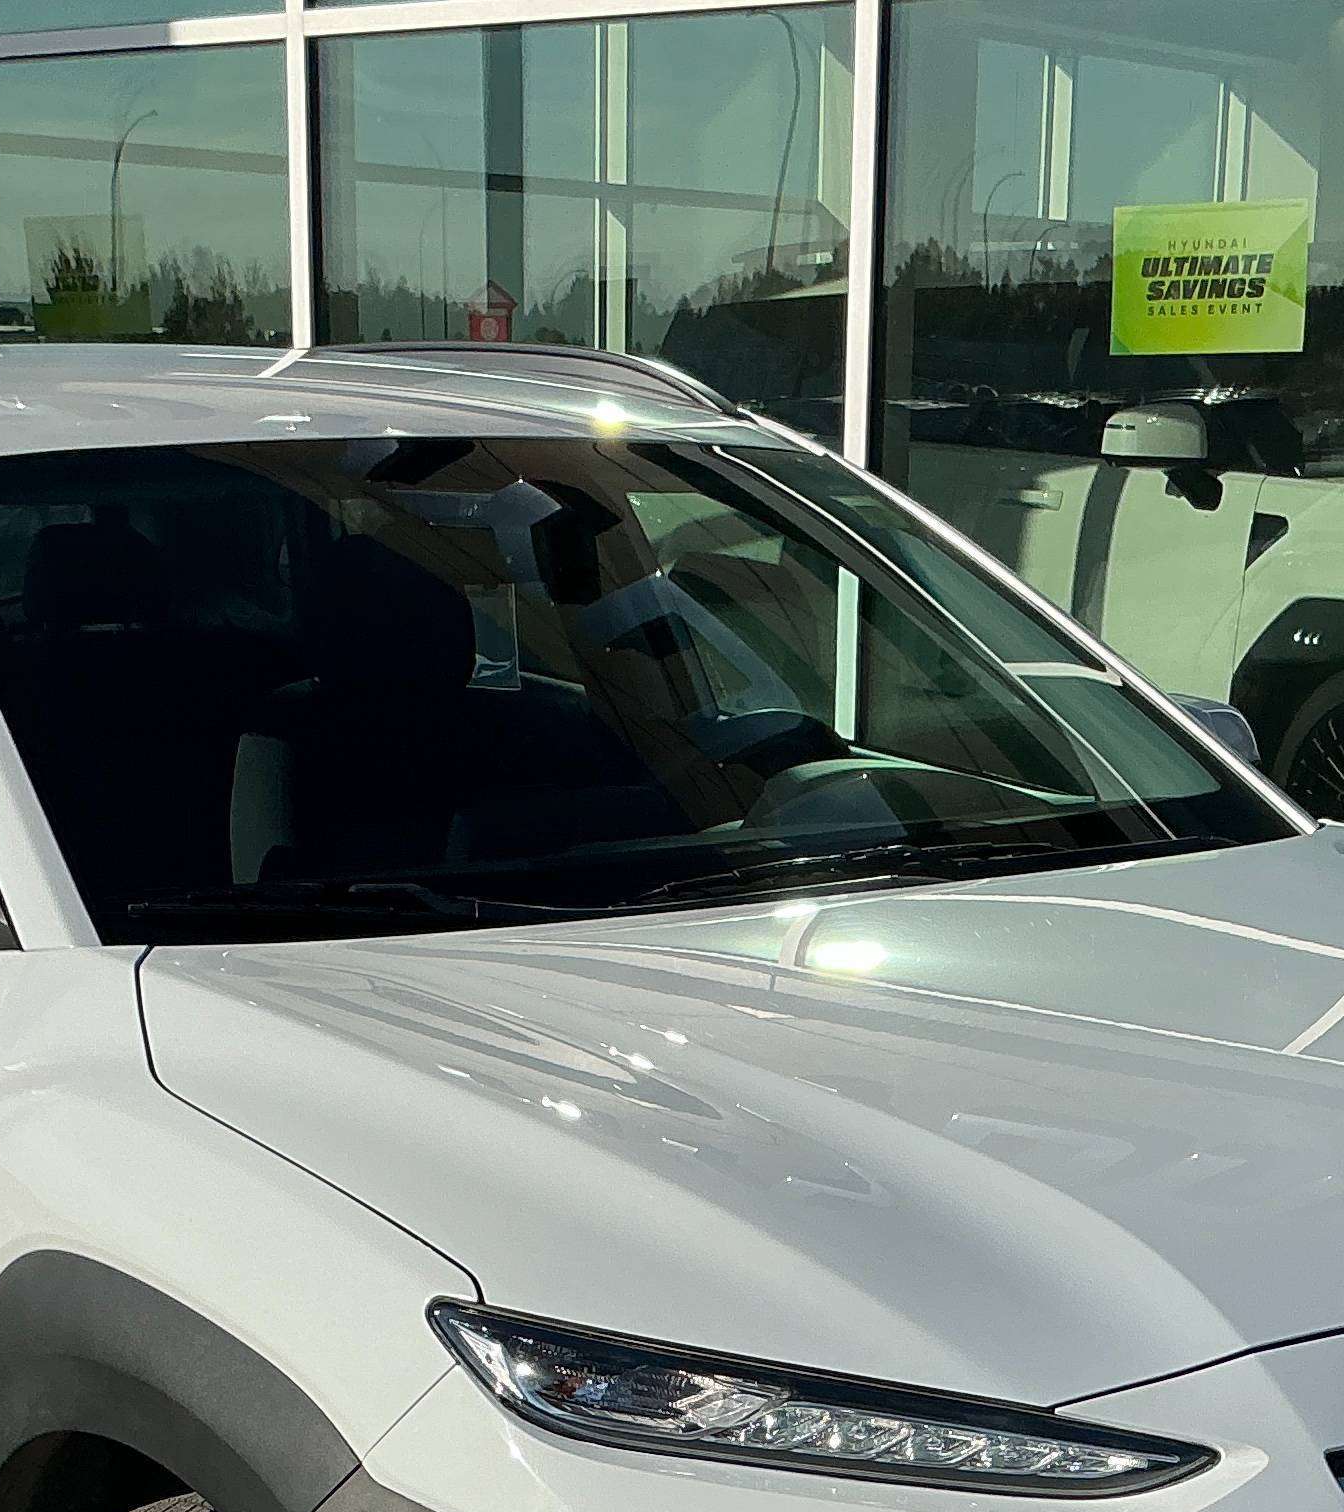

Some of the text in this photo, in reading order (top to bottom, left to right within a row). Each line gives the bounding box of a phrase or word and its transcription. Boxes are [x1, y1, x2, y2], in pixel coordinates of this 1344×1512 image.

[1167, 238, 1248, 251] HYUNDAI
[1141, 253, 1275, 278] ULTIMATE
[1145, 277, 1266, 302] SAVINGS
[1147, 303, 1263, 316] SALES EVENT
